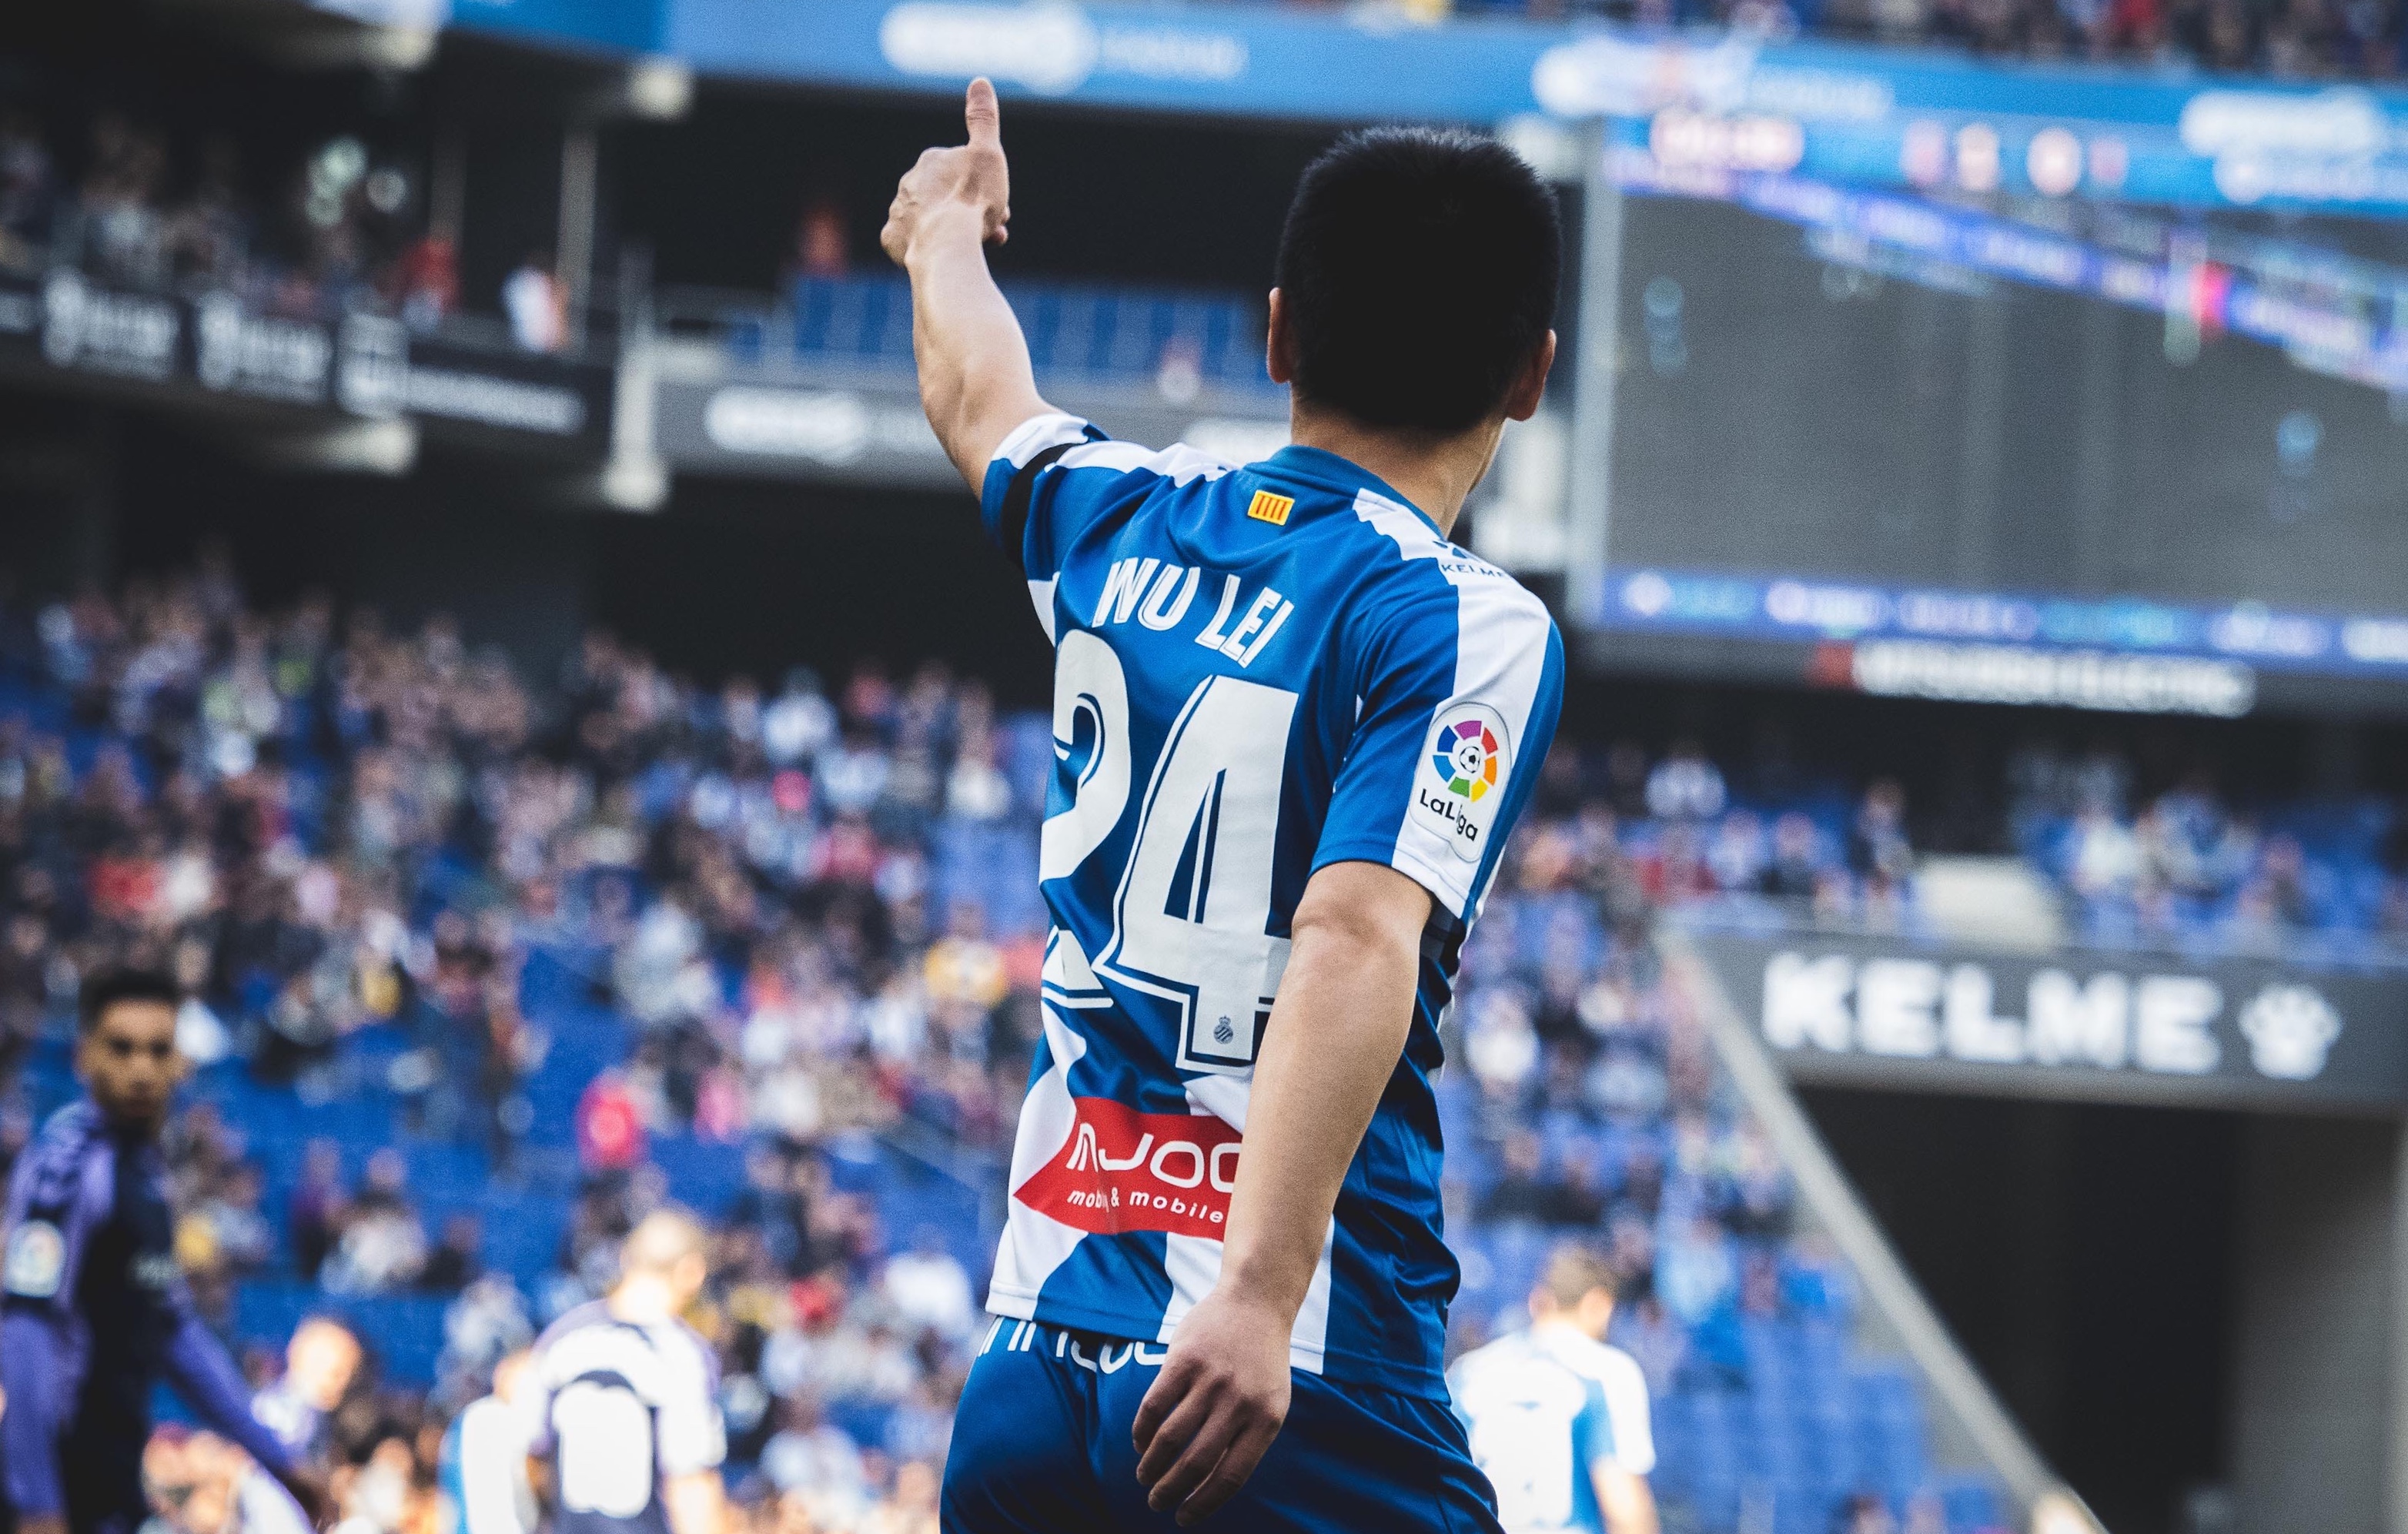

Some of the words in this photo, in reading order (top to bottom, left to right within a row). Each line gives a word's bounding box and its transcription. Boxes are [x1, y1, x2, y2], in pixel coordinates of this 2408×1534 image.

[1092, 556, 1201, 631] WU
[1195, 573, 1295, 669] LEI
[1039, 629, 1299, 1076] 24
[1761, 951, 2225, 1074] KELME
[1129, 1191, 1224, 1223] mobile
